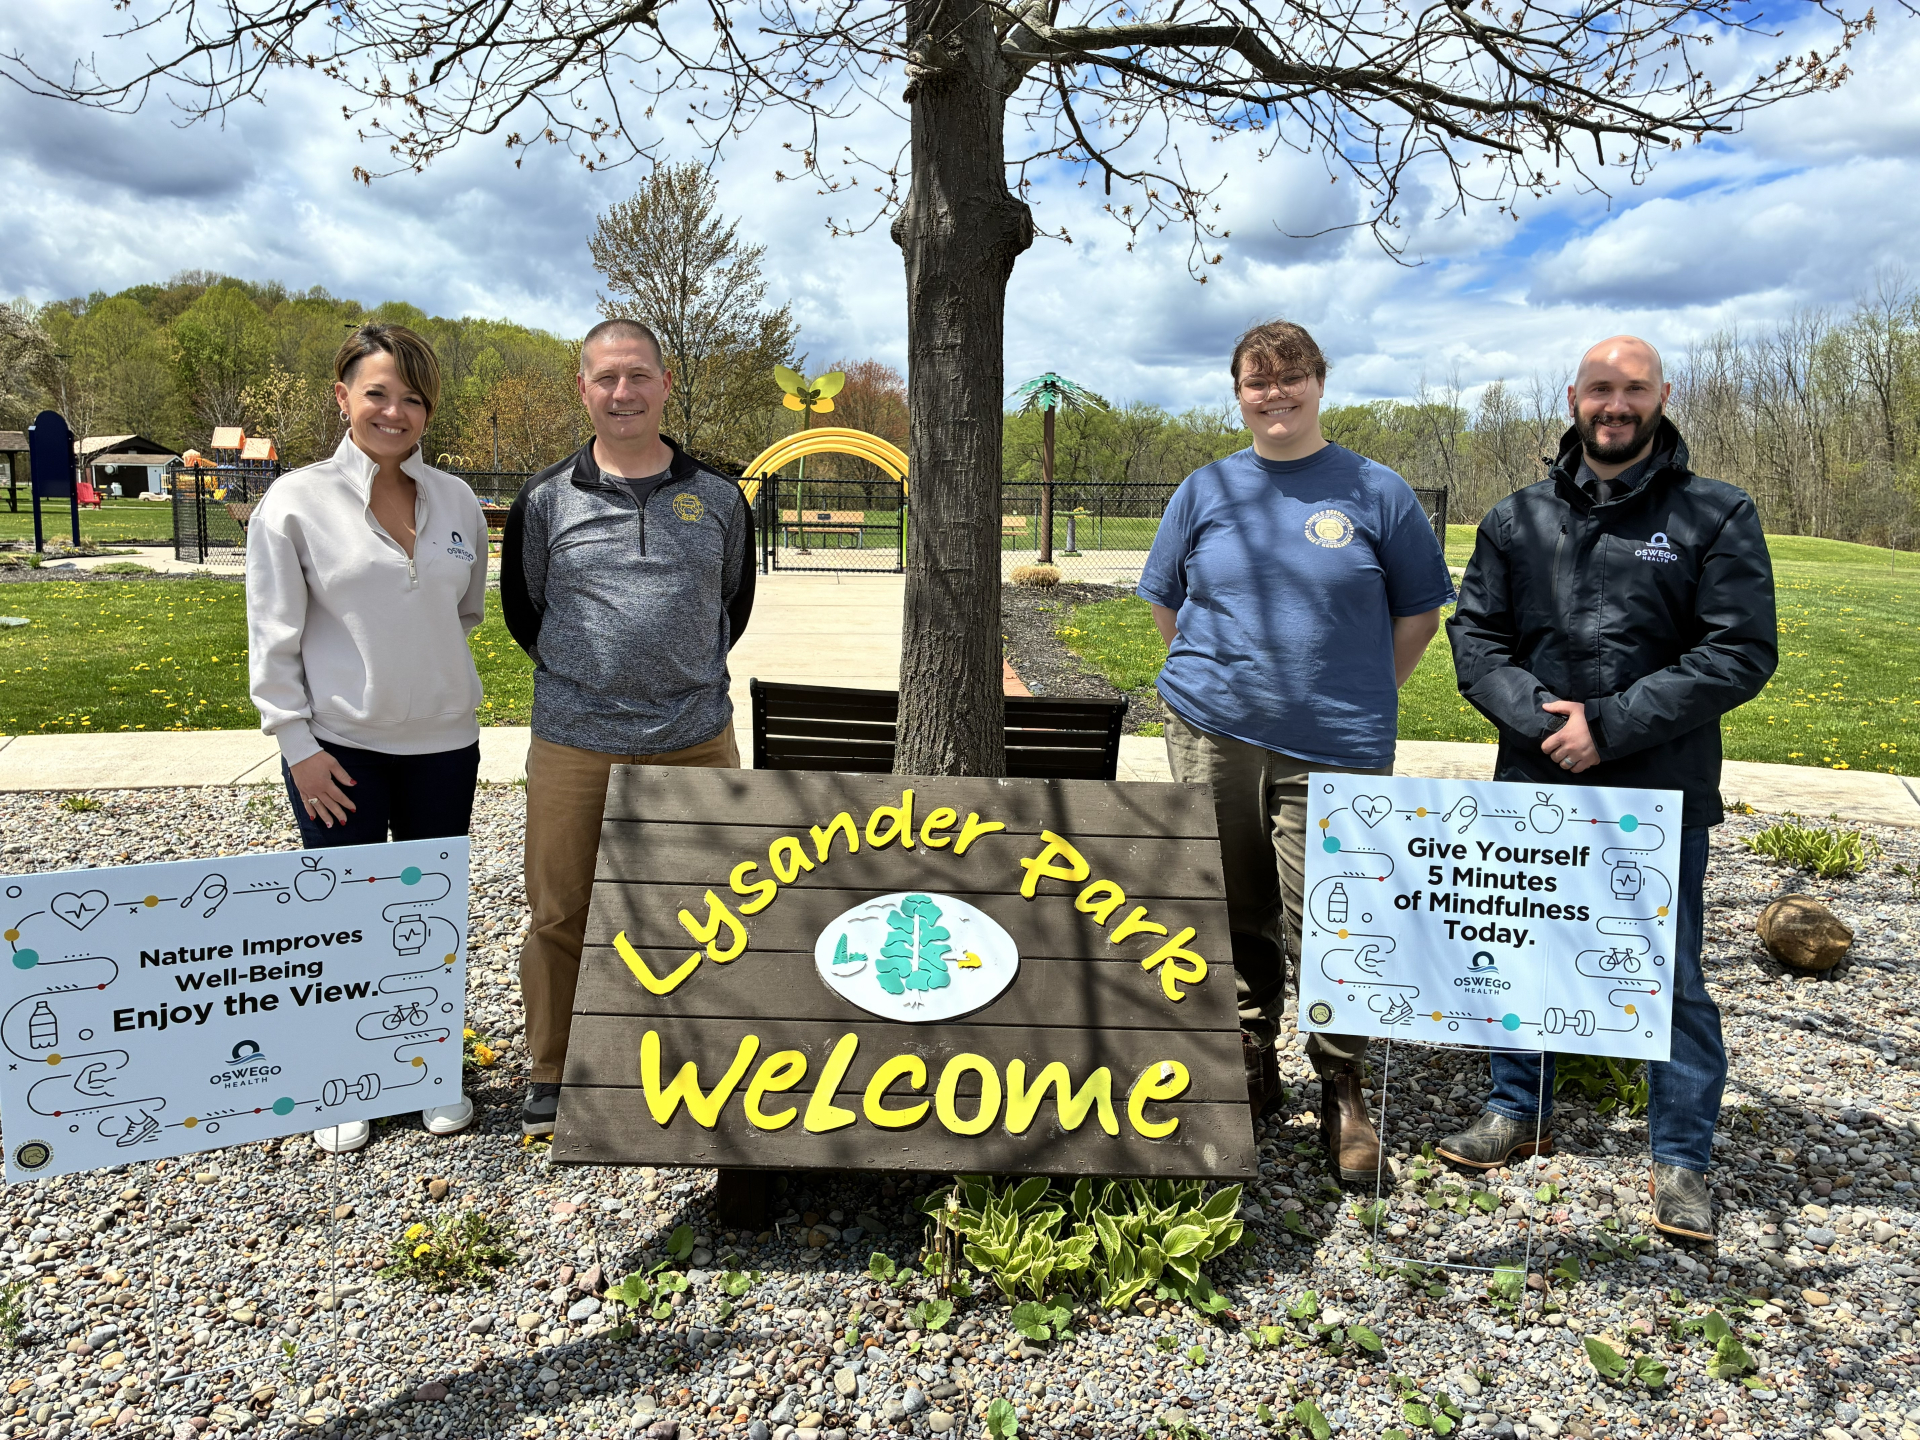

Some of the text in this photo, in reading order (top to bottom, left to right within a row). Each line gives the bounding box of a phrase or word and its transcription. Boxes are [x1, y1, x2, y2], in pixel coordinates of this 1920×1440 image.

[447, 548, 474, 560] OSWEGO
[1635, 549, 1677, 561] OSWEGO
[1407, 837, 1590, 867] Give Yourself
[1427, 865, 1557, 893] 5 Minutes
[614, 790, 1207, 1000] Lysander Park
[1393, 890, 1590, 921] of Mindfulness
[139, 928, 363, 968] Nature Improves
[1443, 919, 1535, 949] Today.
[174, 958, 324, 992] Well-Being
[1453, 976, 1512, 991] OSWEGO
[113, 976, 379, 1033] Enjoy the View.
[1464, 987, 1500, 995] HEALTH
[209, 1065, 282, 1086] OSWEGO
[223, 1077, 268, 1089] HEALTH
